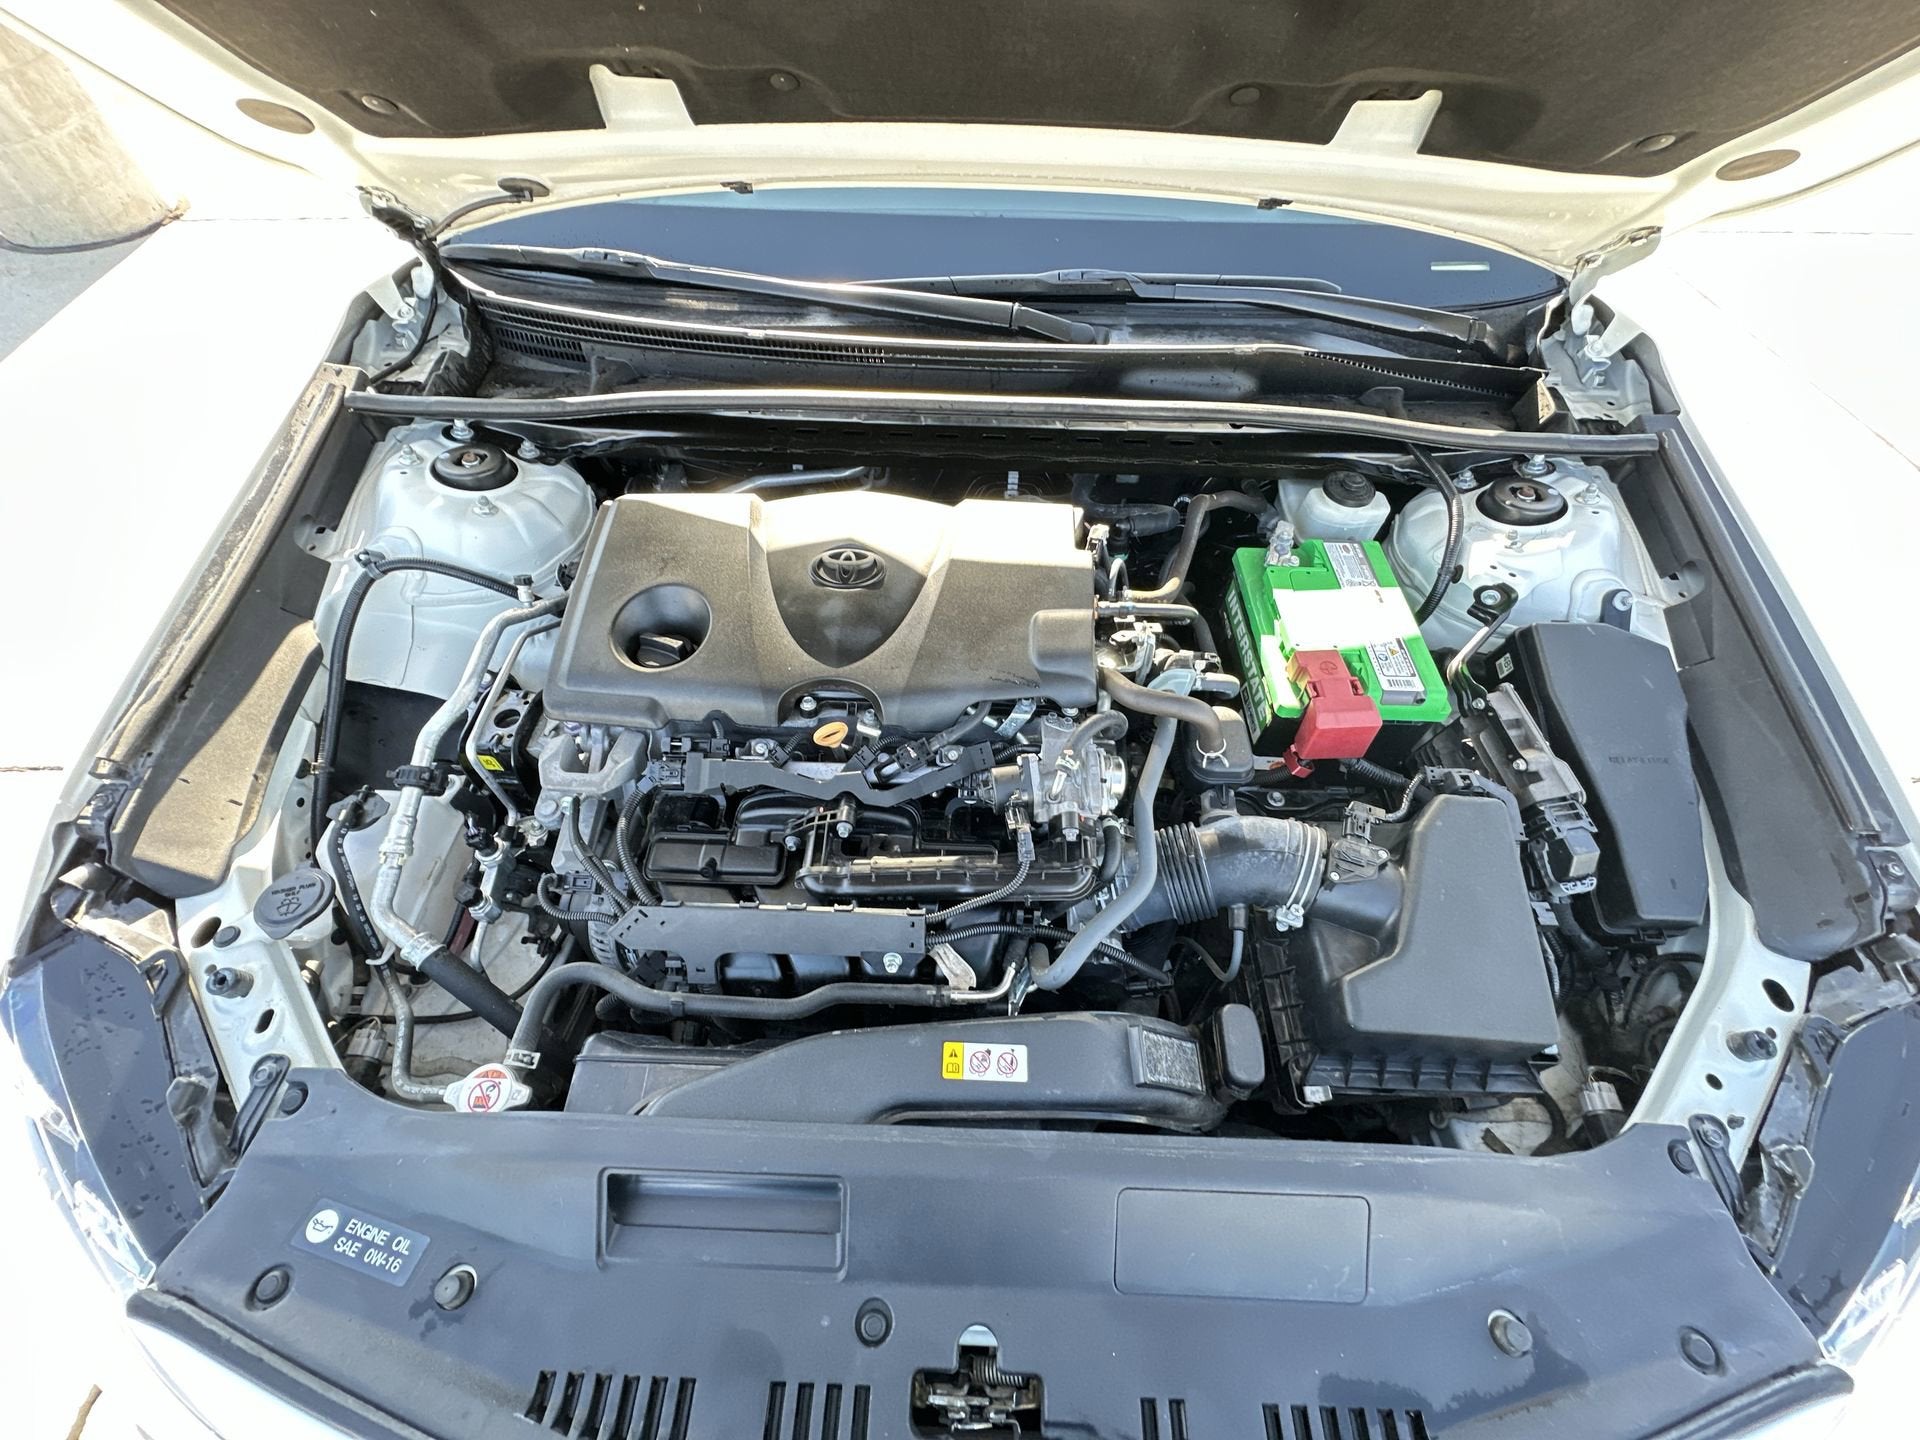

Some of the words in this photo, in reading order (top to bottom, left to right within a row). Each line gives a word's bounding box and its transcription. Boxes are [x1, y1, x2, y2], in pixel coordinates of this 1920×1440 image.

[1228, 590, 1266, 721] INTERSTATE
[333, 1237, 362, 1258] SAE
[364, 1249, 402, 1273] 0W-16
[344, 1218, 390, 1246] ENGINE
[392, 1236, 412, 1256] OIL
